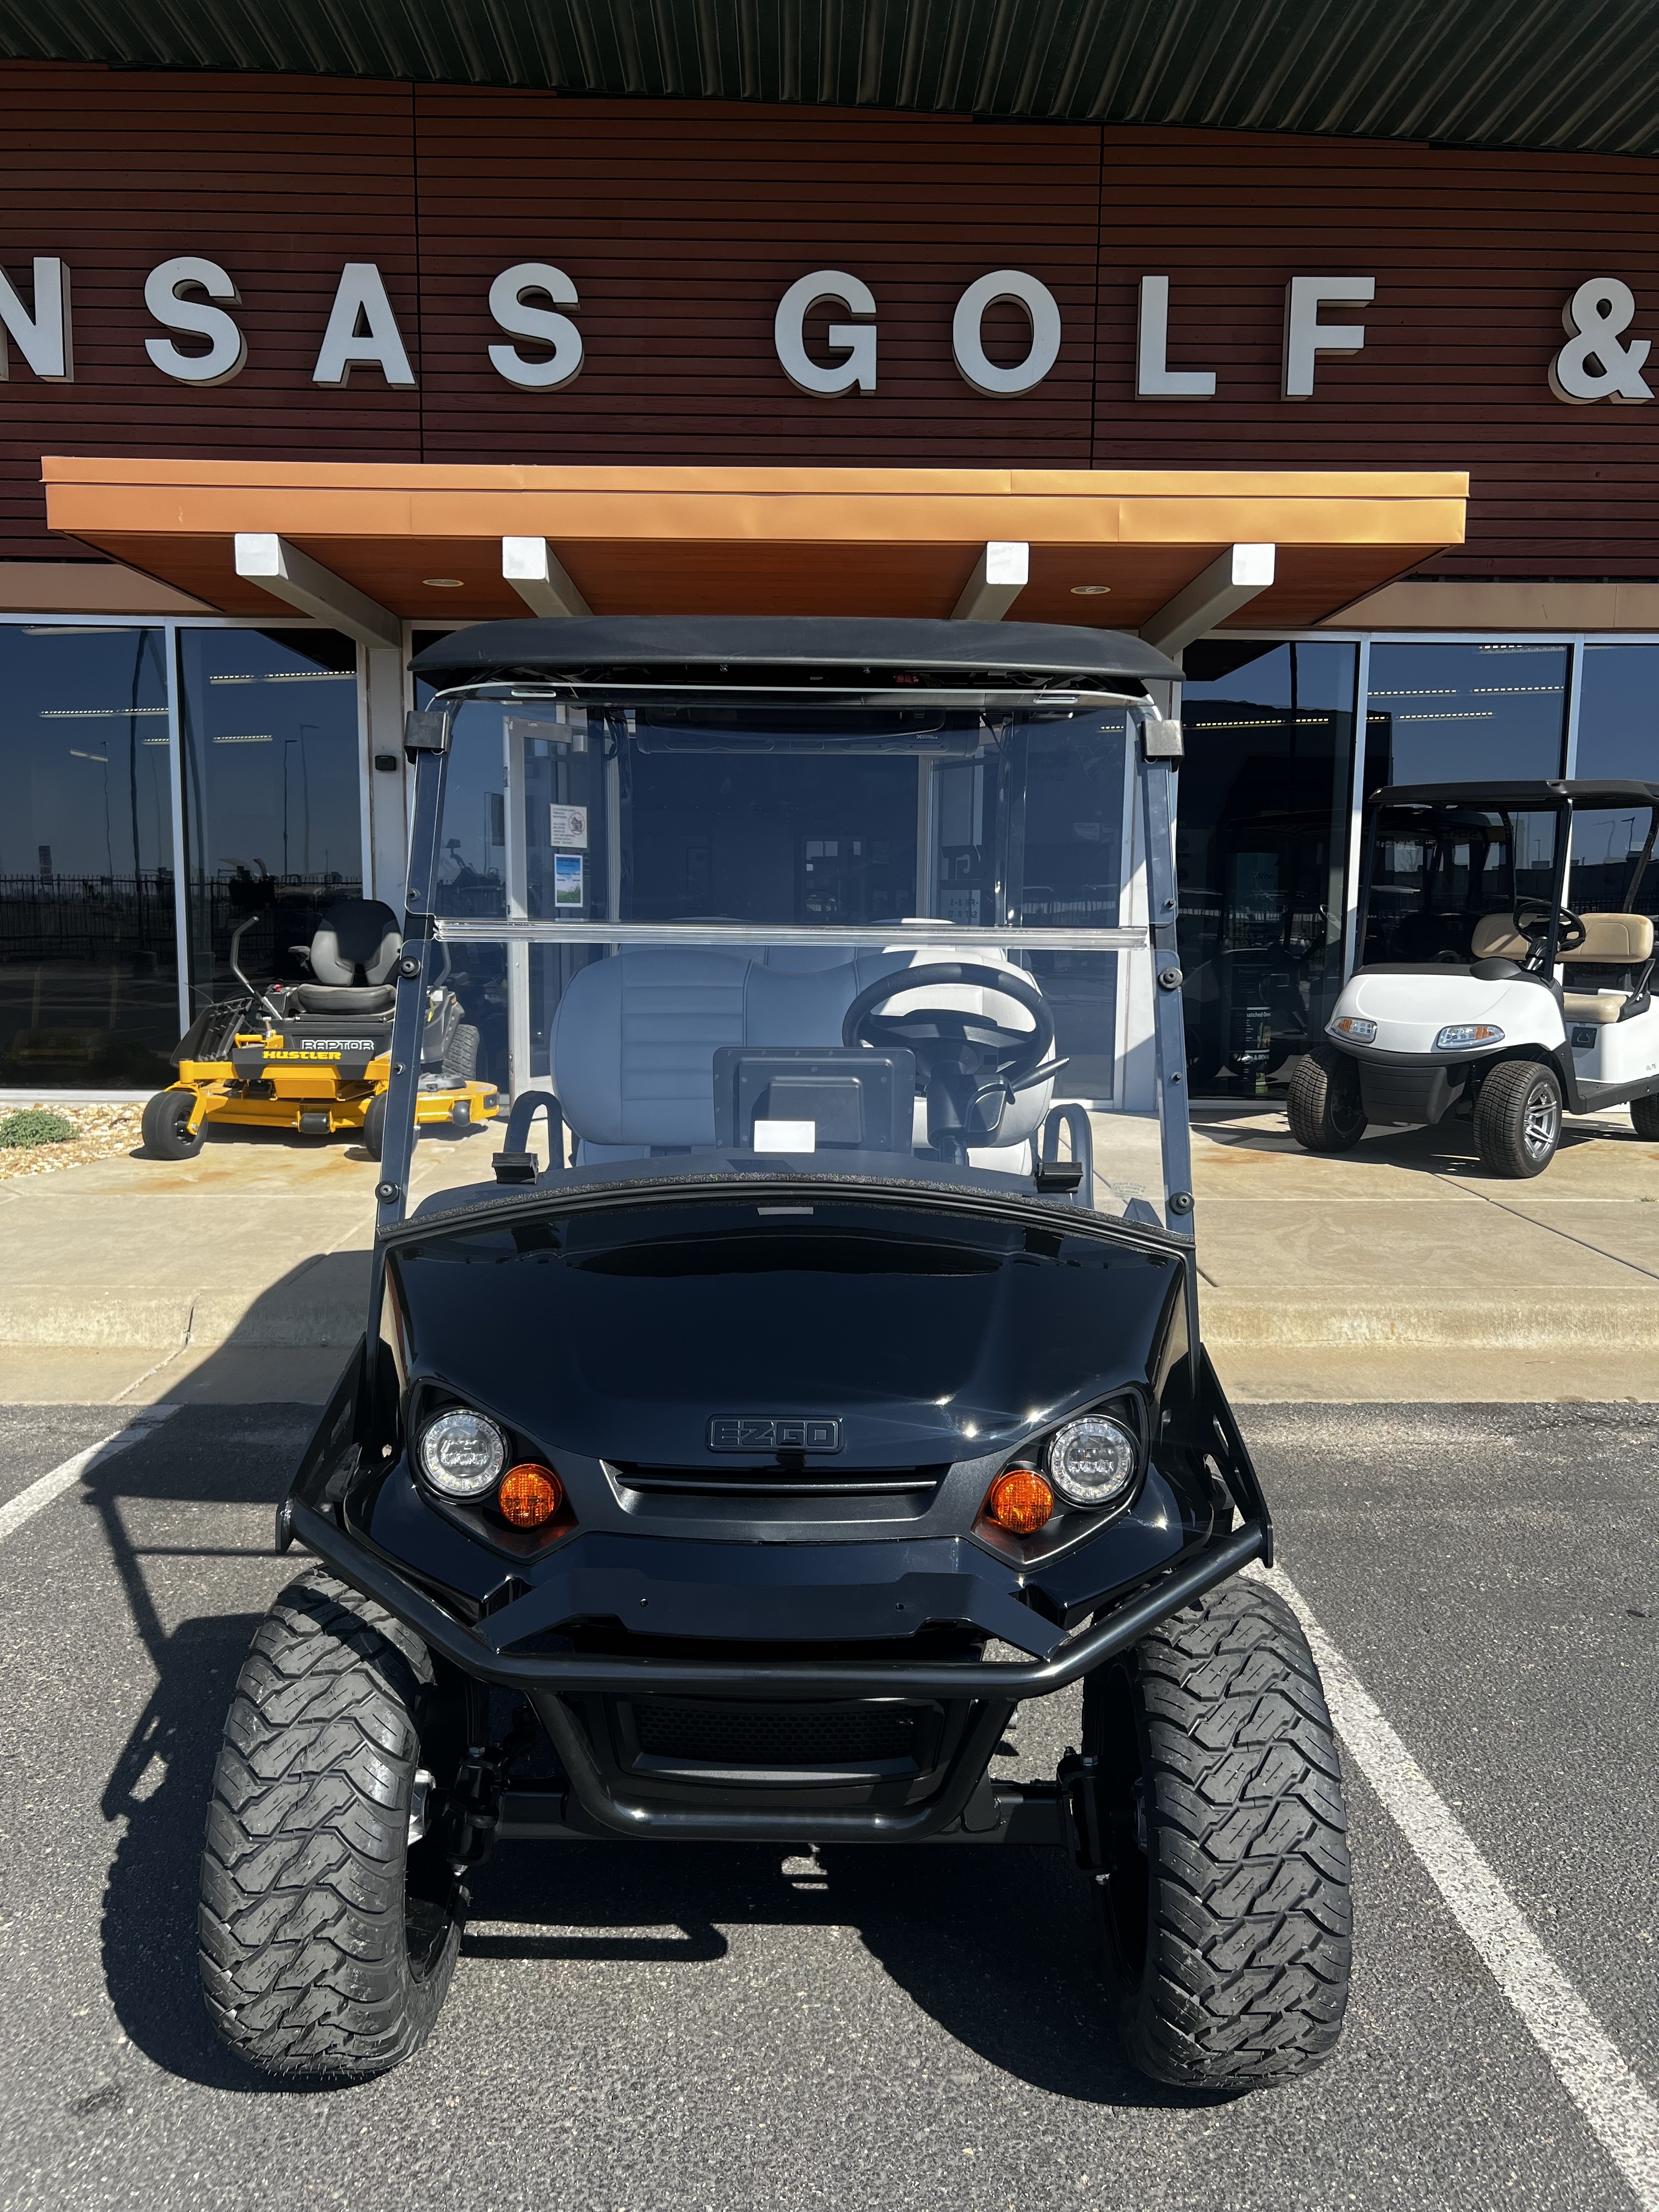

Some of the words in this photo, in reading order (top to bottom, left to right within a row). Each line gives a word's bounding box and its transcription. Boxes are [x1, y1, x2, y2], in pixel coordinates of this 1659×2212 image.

[774, 269, 1376, 402] GOLF
[1548, 276, 1656, 405] &
[302, 1039, 375, 1050] RAPTOR
[262, 1051, 342, 1060] HUSTLER
